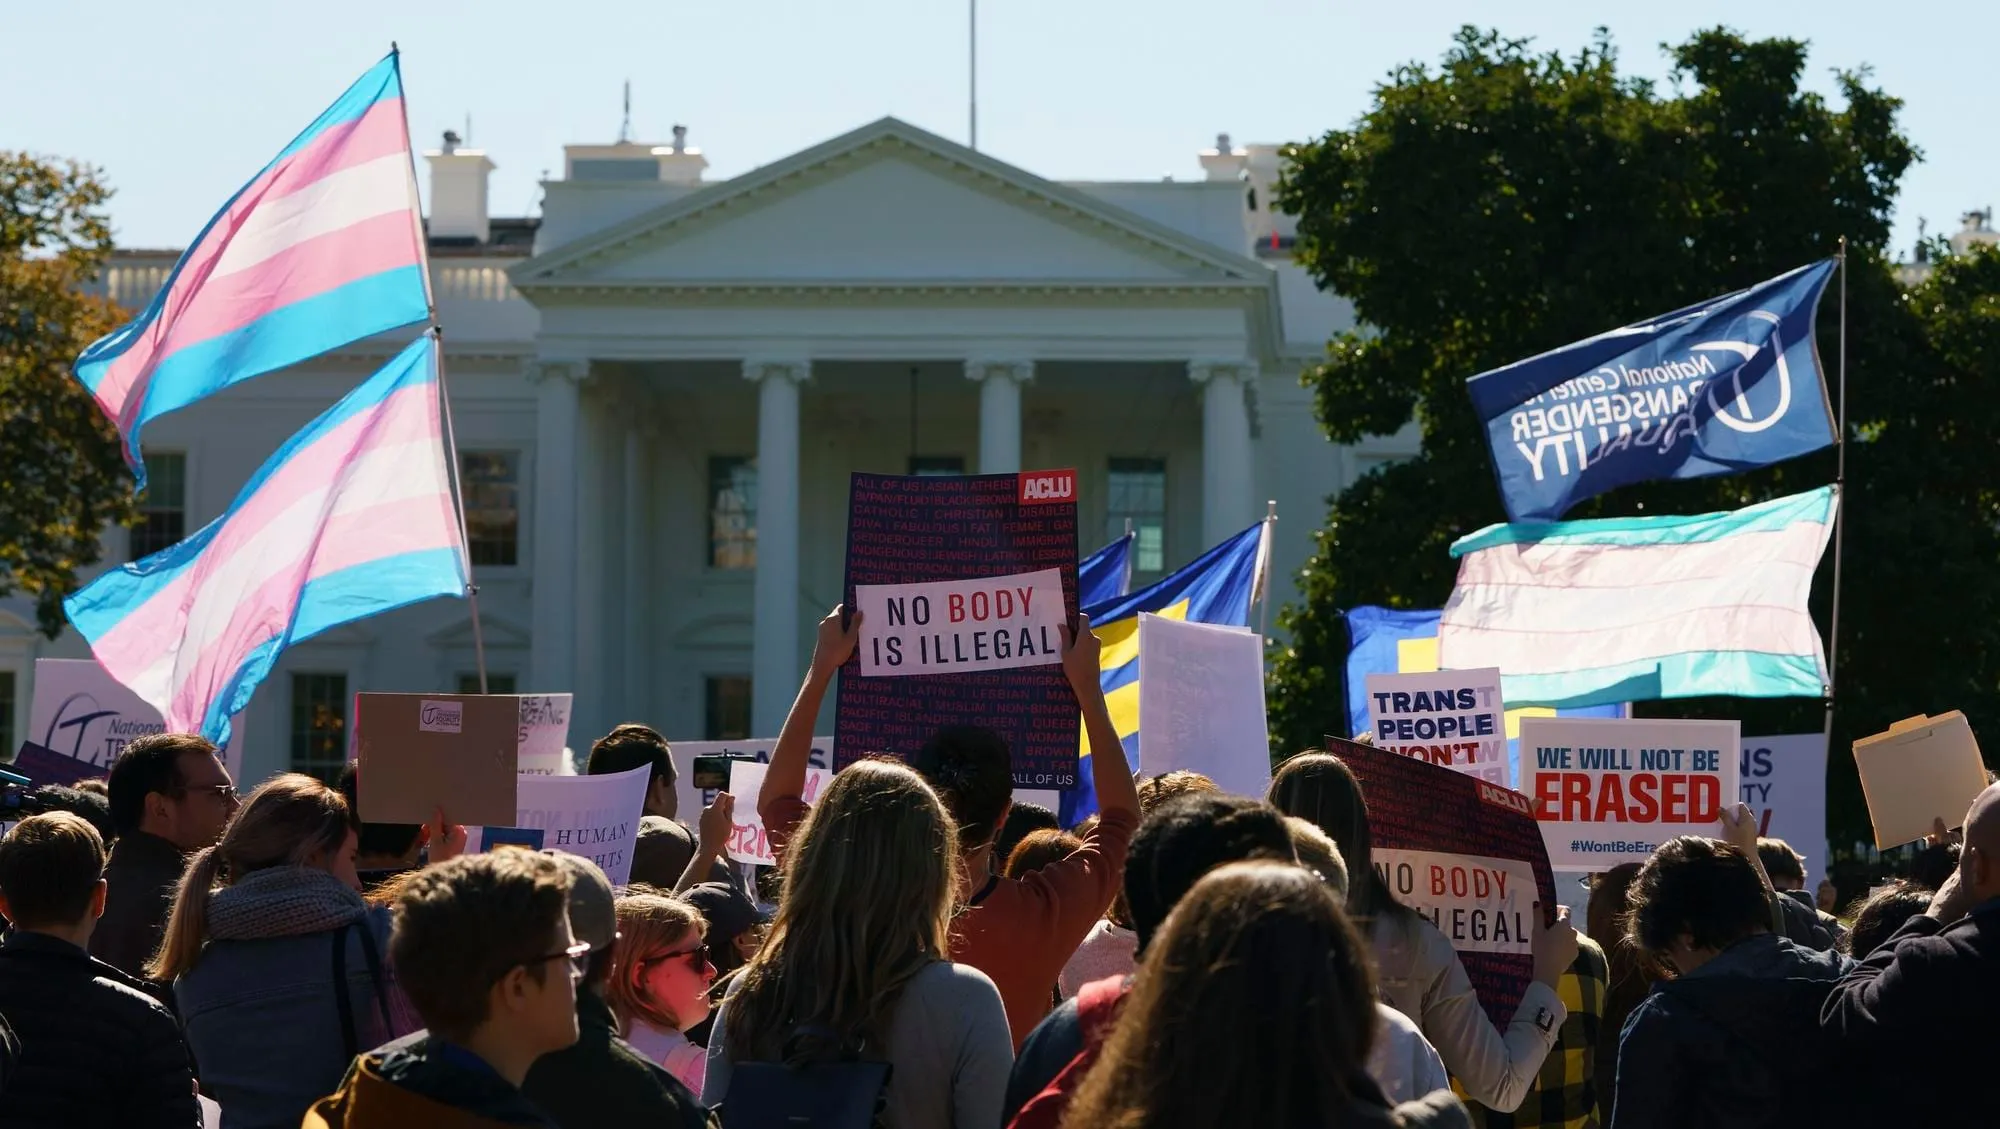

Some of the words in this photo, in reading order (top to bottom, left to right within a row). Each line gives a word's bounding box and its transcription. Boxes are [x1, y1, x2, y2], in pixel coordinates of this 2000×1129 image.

[856, 478, 875, 489] ALL
[881, 480, 898, 490] OF
[902, 480, 920, 491] US
[927, 481, 963, 491] ASIAN
[969, 479, 1016, 491] ATHEIST
[1023, 476, 1072, 500] ACLU
[934, 494, 970, 506] BLACK
[975, 494, 1016, 505] BROWN
[854, 505, 918, 519] CATHOLIC
[934, 508, 1004, 520] CHRISTIAN
[1018, 505, 1074, 518] DISABLED
[853, 518, 881, 528] DIVA
[894, 521, 959, 533] FABULOUS
[970, 522, 992, 533] FAT
[1002, 521, 1044, 533] FEMME
[1053, 519, 1074, 530] GAY
[852, 531, 943, 546] GENDERQUEER
[959, 537, 998, 547] HINDU
[1013, 533, 1074, 546] IMMIGRANT
[852, 544, 927, 559] INDIGENOUS
[932, 550, 976, 560] JEWISH
[985, 551, 1024, 561] LATINX
[1032, 549, 1075, 561] LESBIAN
[851, 558, 877, 568] MAN
[883, 561, 954, 574] MULTIRACIAL
[962, 564, 1006, 575] MUSLIM
[850, 570, 896, 584] PACIFIC
[887, 595, 930, 627] NO
[949, 587, 1033, 623] BODY
[873, 636, 903, 666] IS
[921, 626, 1056, 665] ILLEGAL
[1007, 675, 1071, 686] IMMIGRAN
[844, 680, 892, 692] JEWISH
[908, 685, 956, 696] LATINX
[972, 687, 1029, 700] LESBIAN
[842, 694, 924, 709] MULTIRACIAL
[935, 701, 985, 713] MUSLIM
[996, 702, 1076, 715] NON-BINARY
[1373, 688, 1476, 713] TRANS
[841, 706, 889, 720] PACIFIC
[895, 712, 958, 725] ISLANDER
[973, 716, 1018, 727] QUEEN
[1032, 718, 1076, 729] QUEER
[840, 720, 871, 732] SAGE
[883, 723, 912, 735] SIKH
[1377, 713, 1494, 740] PEOPLE
[840, 734, 885, 747] YOUNG
[1025, 732, 1075, 744] WOMAN
[1025, 746, 1074, 757] BROWN
[1537, 747, 1572, 769] WE
[1579, 748, 1632, 770] WILL
[1640, 749, 1684, 771] NOT
[1692, 749, 1720, 771] BE
[1050, 760, 1074, 771] FAT
[1012, 773, 1032, 784] ALL
[1035, 773, 1053, 785] OF
[1056, 774, 1074, 785] US
[1480, 783, 1529, 813] ACLU
[1535, 772, 1720, 823] ERASED
[556, 822, 629, 845] HUMAN
[1571, 840, 1656, 853] #WontBeEra
[1430, 865, 1507, 900] BODY
